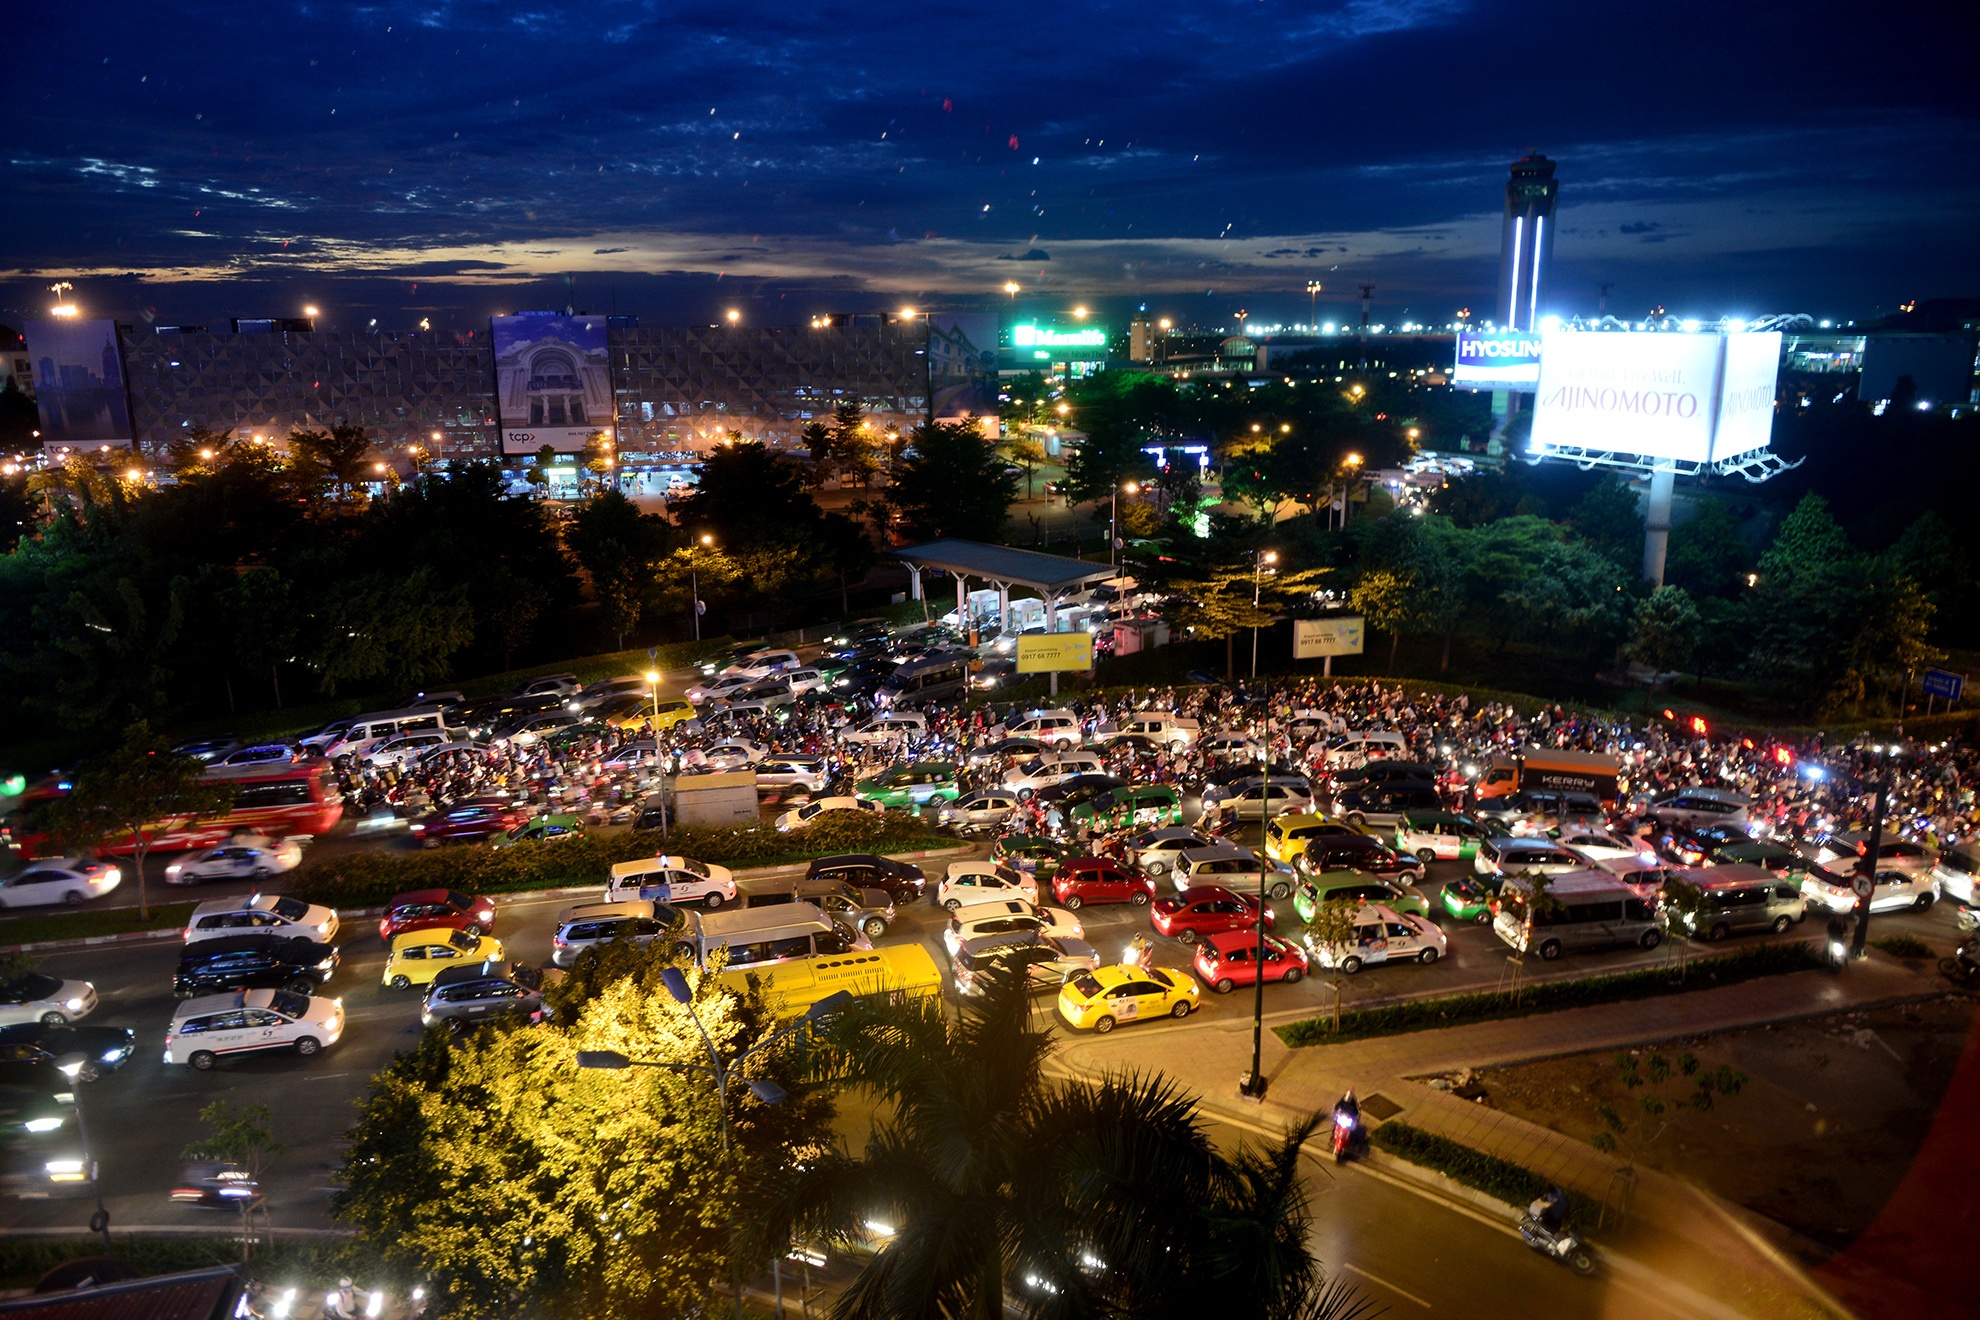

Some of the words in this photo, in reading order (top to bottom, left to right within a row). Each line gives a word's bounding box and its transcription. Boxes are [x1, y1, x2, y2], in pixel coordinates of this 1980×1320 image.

[1461, 340, 1542, 358] HYOSUN
[1542, 386, 1698, 418] AJINOMOTO
[1542, 775, 1595, 788] KERRY
